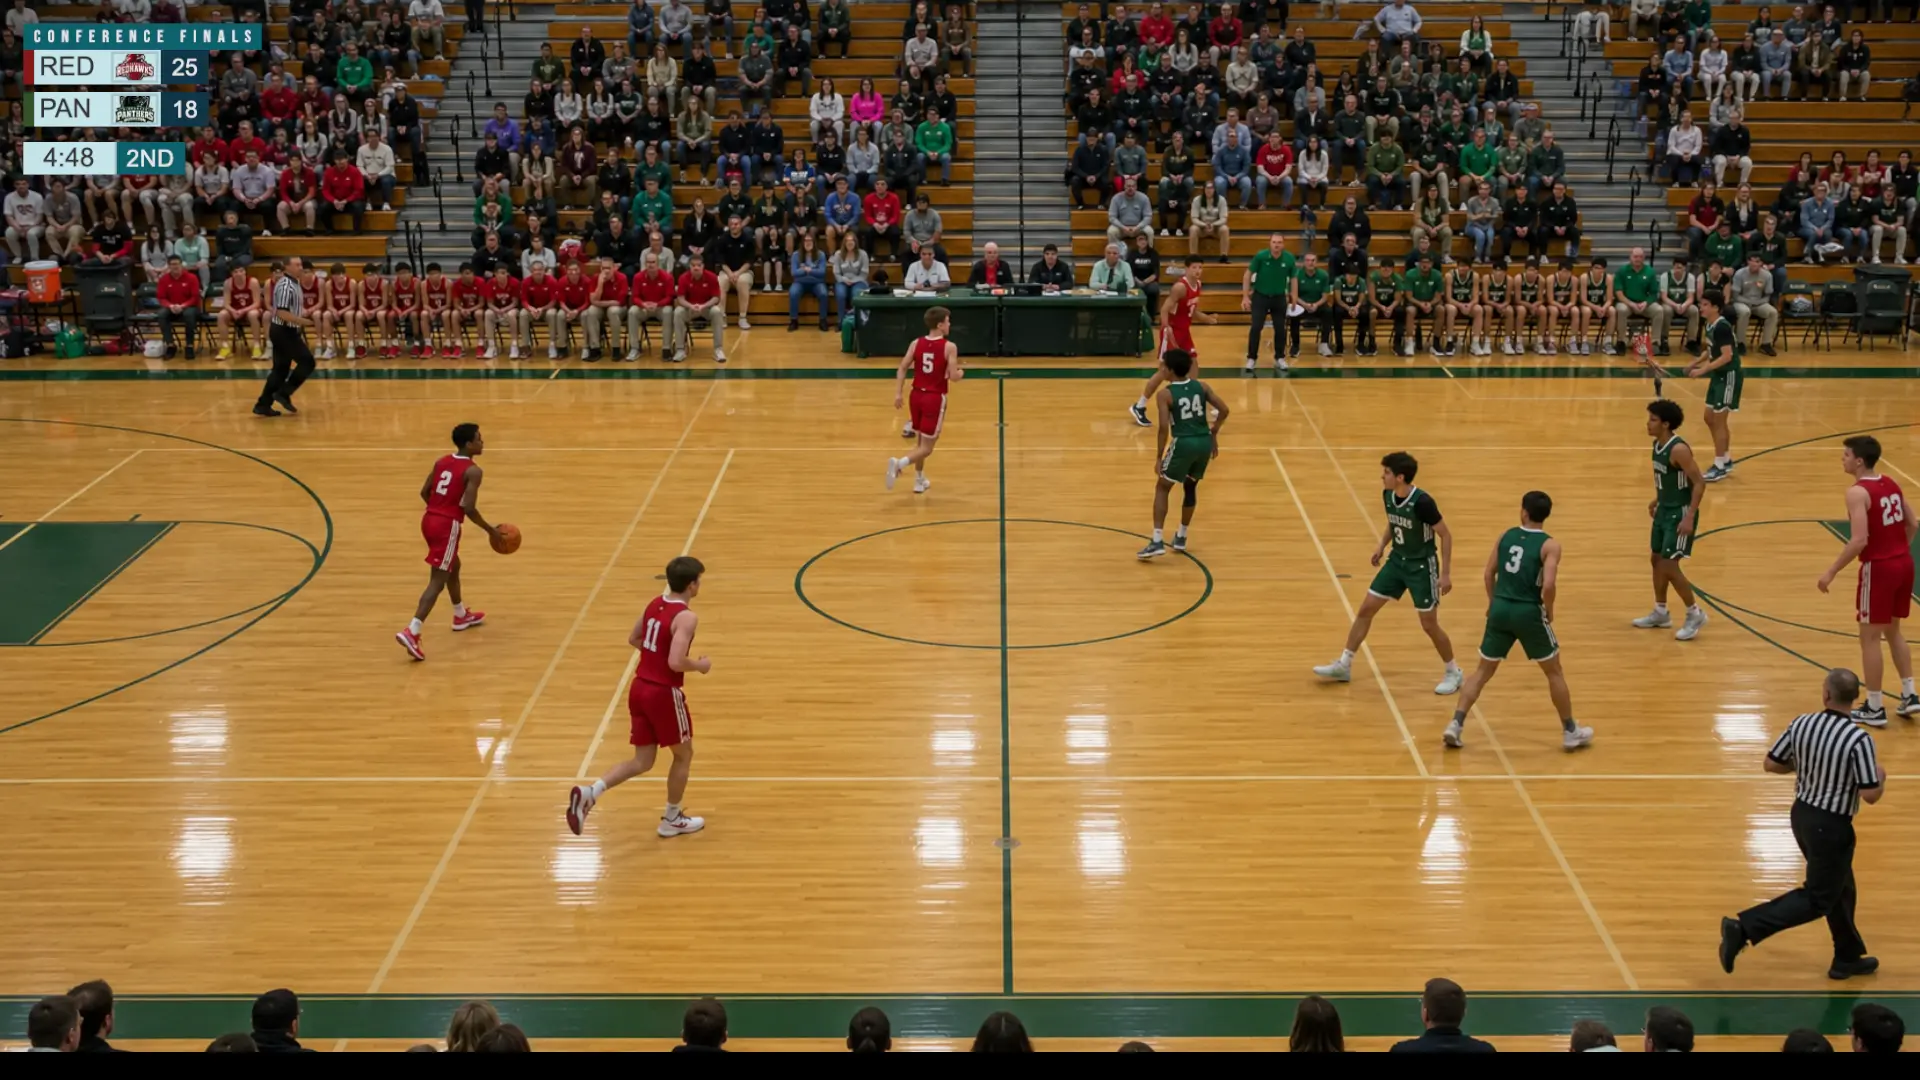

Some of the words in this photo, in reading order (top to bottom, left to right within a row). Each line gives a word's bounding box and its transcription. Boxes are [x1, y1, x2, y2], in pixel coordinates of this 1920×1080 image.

[922, 352, 935, 374] 5
[1178, 393, 1204, 420] 24
[435, 471, 452, 495] 2
[1879, 493, 1904, 526] 23
[1393, 526, 1405, 545] 3
[1504, 544, 1524, 574] 3
[642, 617, 661, 653] 11
